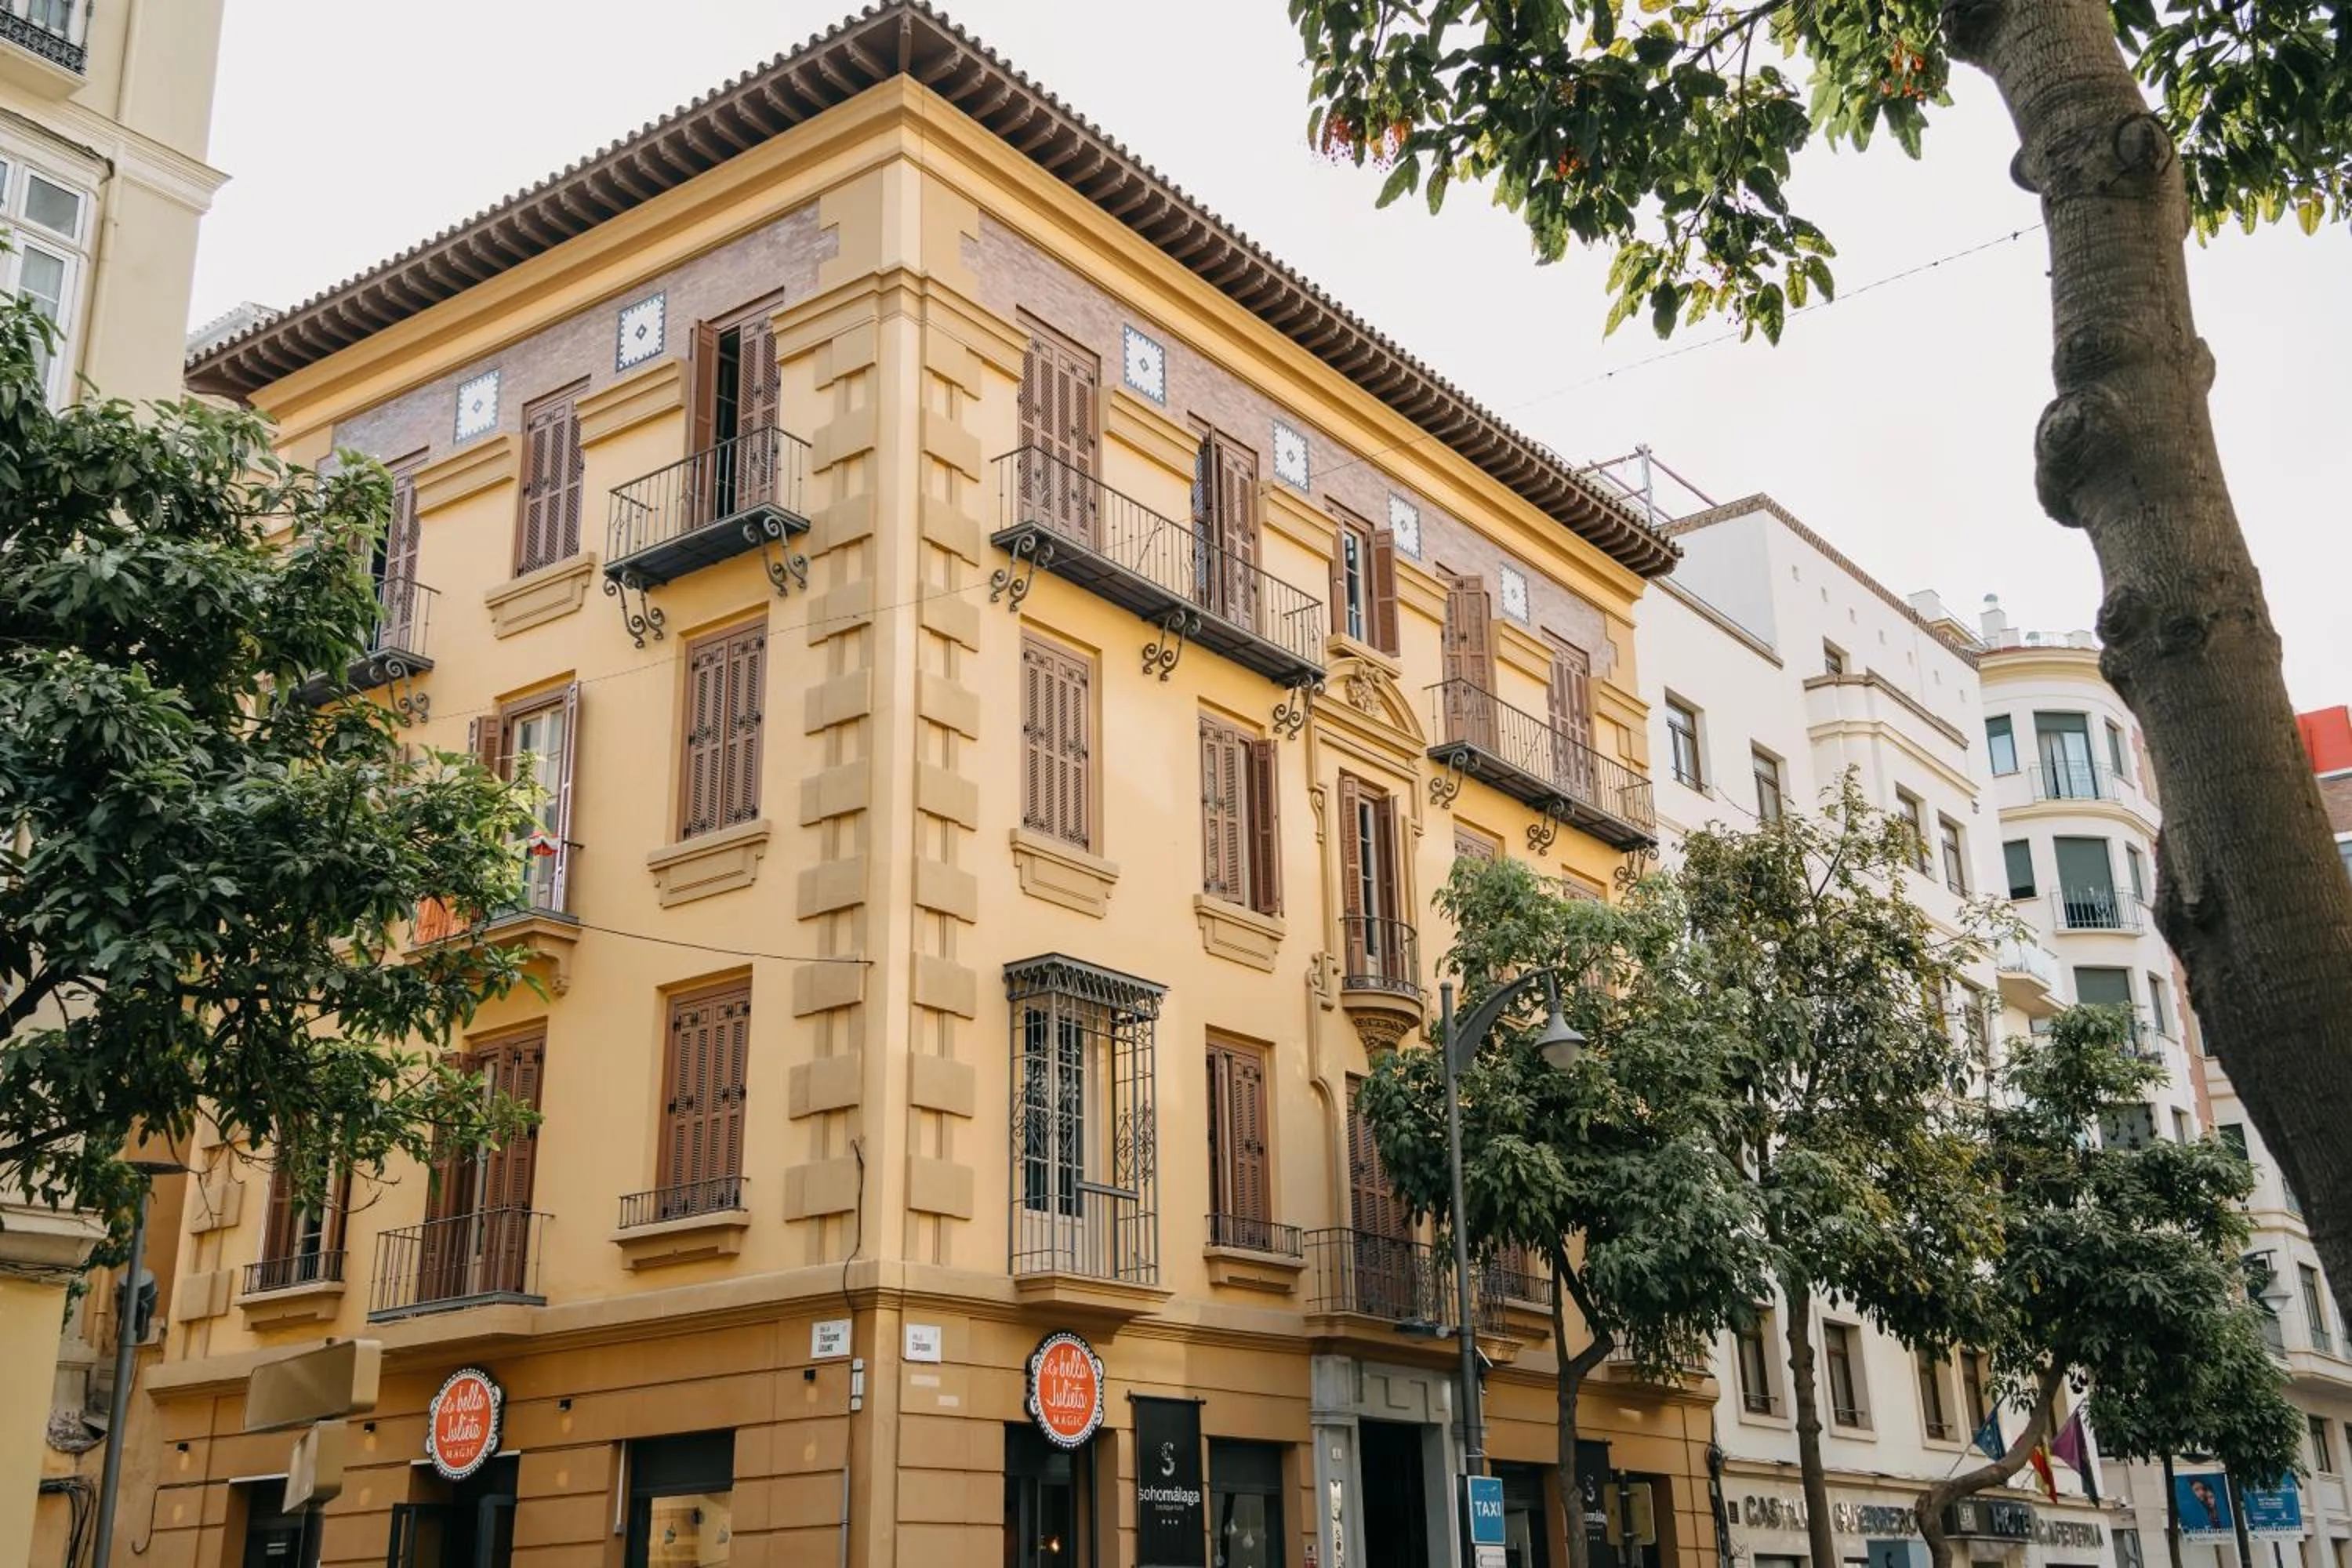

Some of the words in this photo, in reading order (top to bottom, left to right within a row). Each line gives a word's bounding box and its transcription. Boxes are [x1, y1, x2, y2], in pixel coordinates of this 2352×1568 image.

[1059, 1348, 1088, 1379] bella
[457, 1383, 485, 1413] bella
[1045, 1378, 1087, 1409] Julieta
[441, 1414, 482, 1443] Julieta
[1053, 1414, 1082, 1427] MAGIC
[1138, 1485, 1200, 1506] sohomálaga
[1475, 1501, 1501, 1518] TAXI
